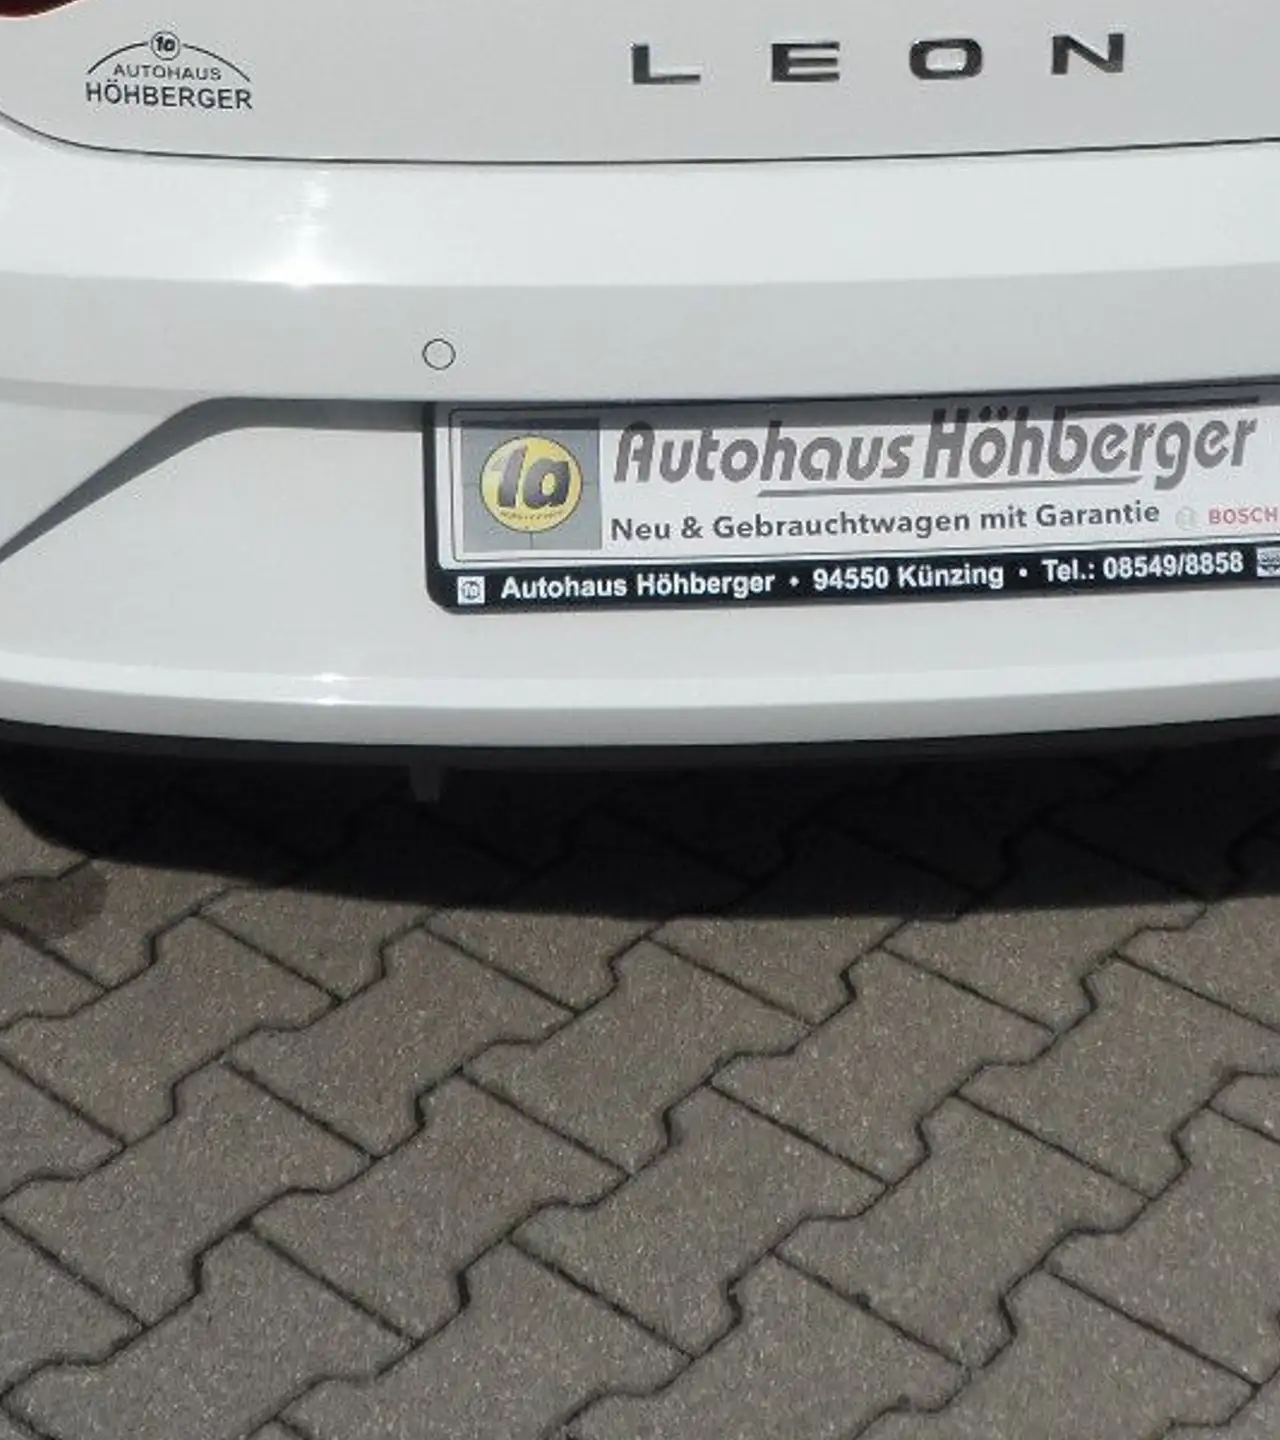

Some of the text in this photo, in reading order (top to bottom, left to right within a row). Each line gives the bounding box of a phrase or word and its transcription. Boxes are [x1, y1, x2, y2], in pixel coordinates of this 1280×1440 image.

[113, 63, 222, 81] AUTOHAUS
[631, 32, 1125, 86] LEON
[85, 79, 253, 110] HÖHBERGER
[613, 405, 1258, 491] Autohaus Höhberger
[611, 499, 1161, 541] Neu & Gebrauchtwagen mit Garantie
[1207, 506, 1279, 526] BOSCH
[500, 575, 628, 599] Autohaus
[637, 571, 777, 600] Höhberger
[812, 566, 890, 592] 94550
[897, 562, 1005, 589] Künzing
[1041, 559, 1096, 583] Tel.:
[1102, 551, 1244, 580] 08549/8858
